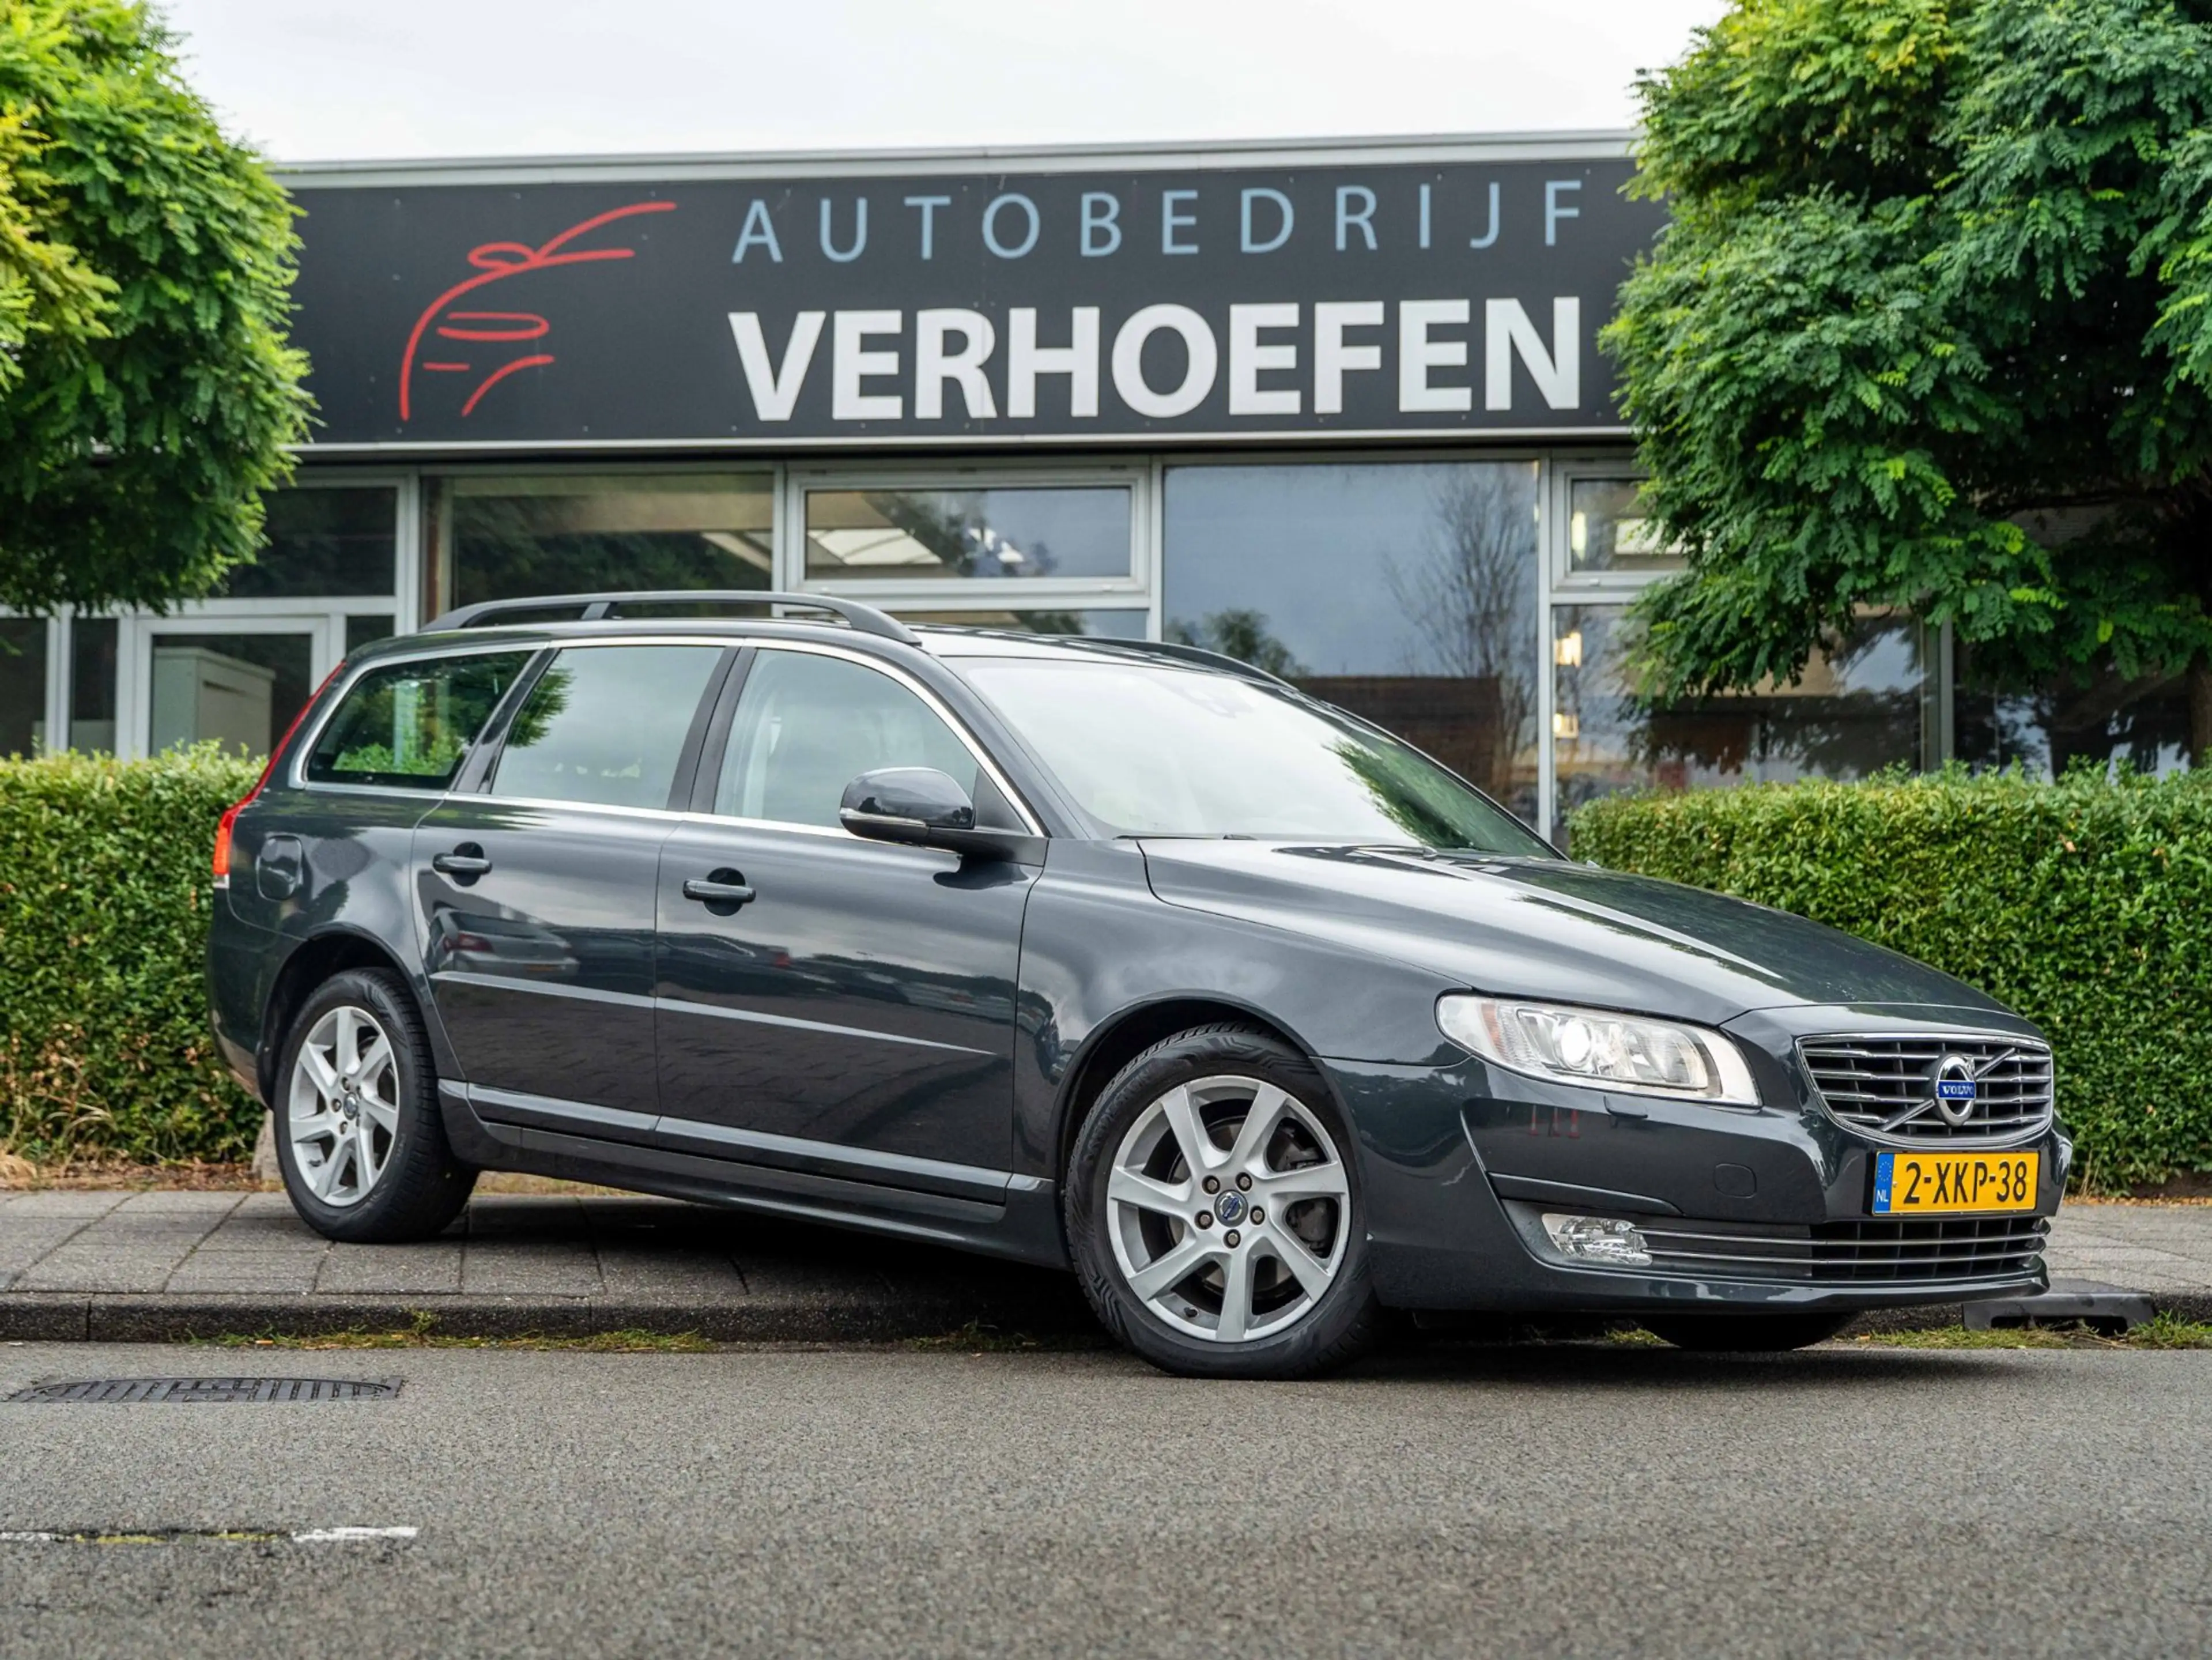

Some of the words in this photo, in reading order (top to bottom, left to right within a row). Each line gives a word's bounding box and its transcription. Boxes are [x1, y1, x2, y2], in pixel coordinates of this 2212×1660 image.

[731, 180, 1583, 264] AUTOBEDRIJF
[728, 296, 1580, 421] VERHOEFEN
[1942, 1085, 1974, 1095] VOLVO
[1876, 1190, 1889, 1203] NL
[1903, 1161, 2027, 1205] 2-XKP-38
